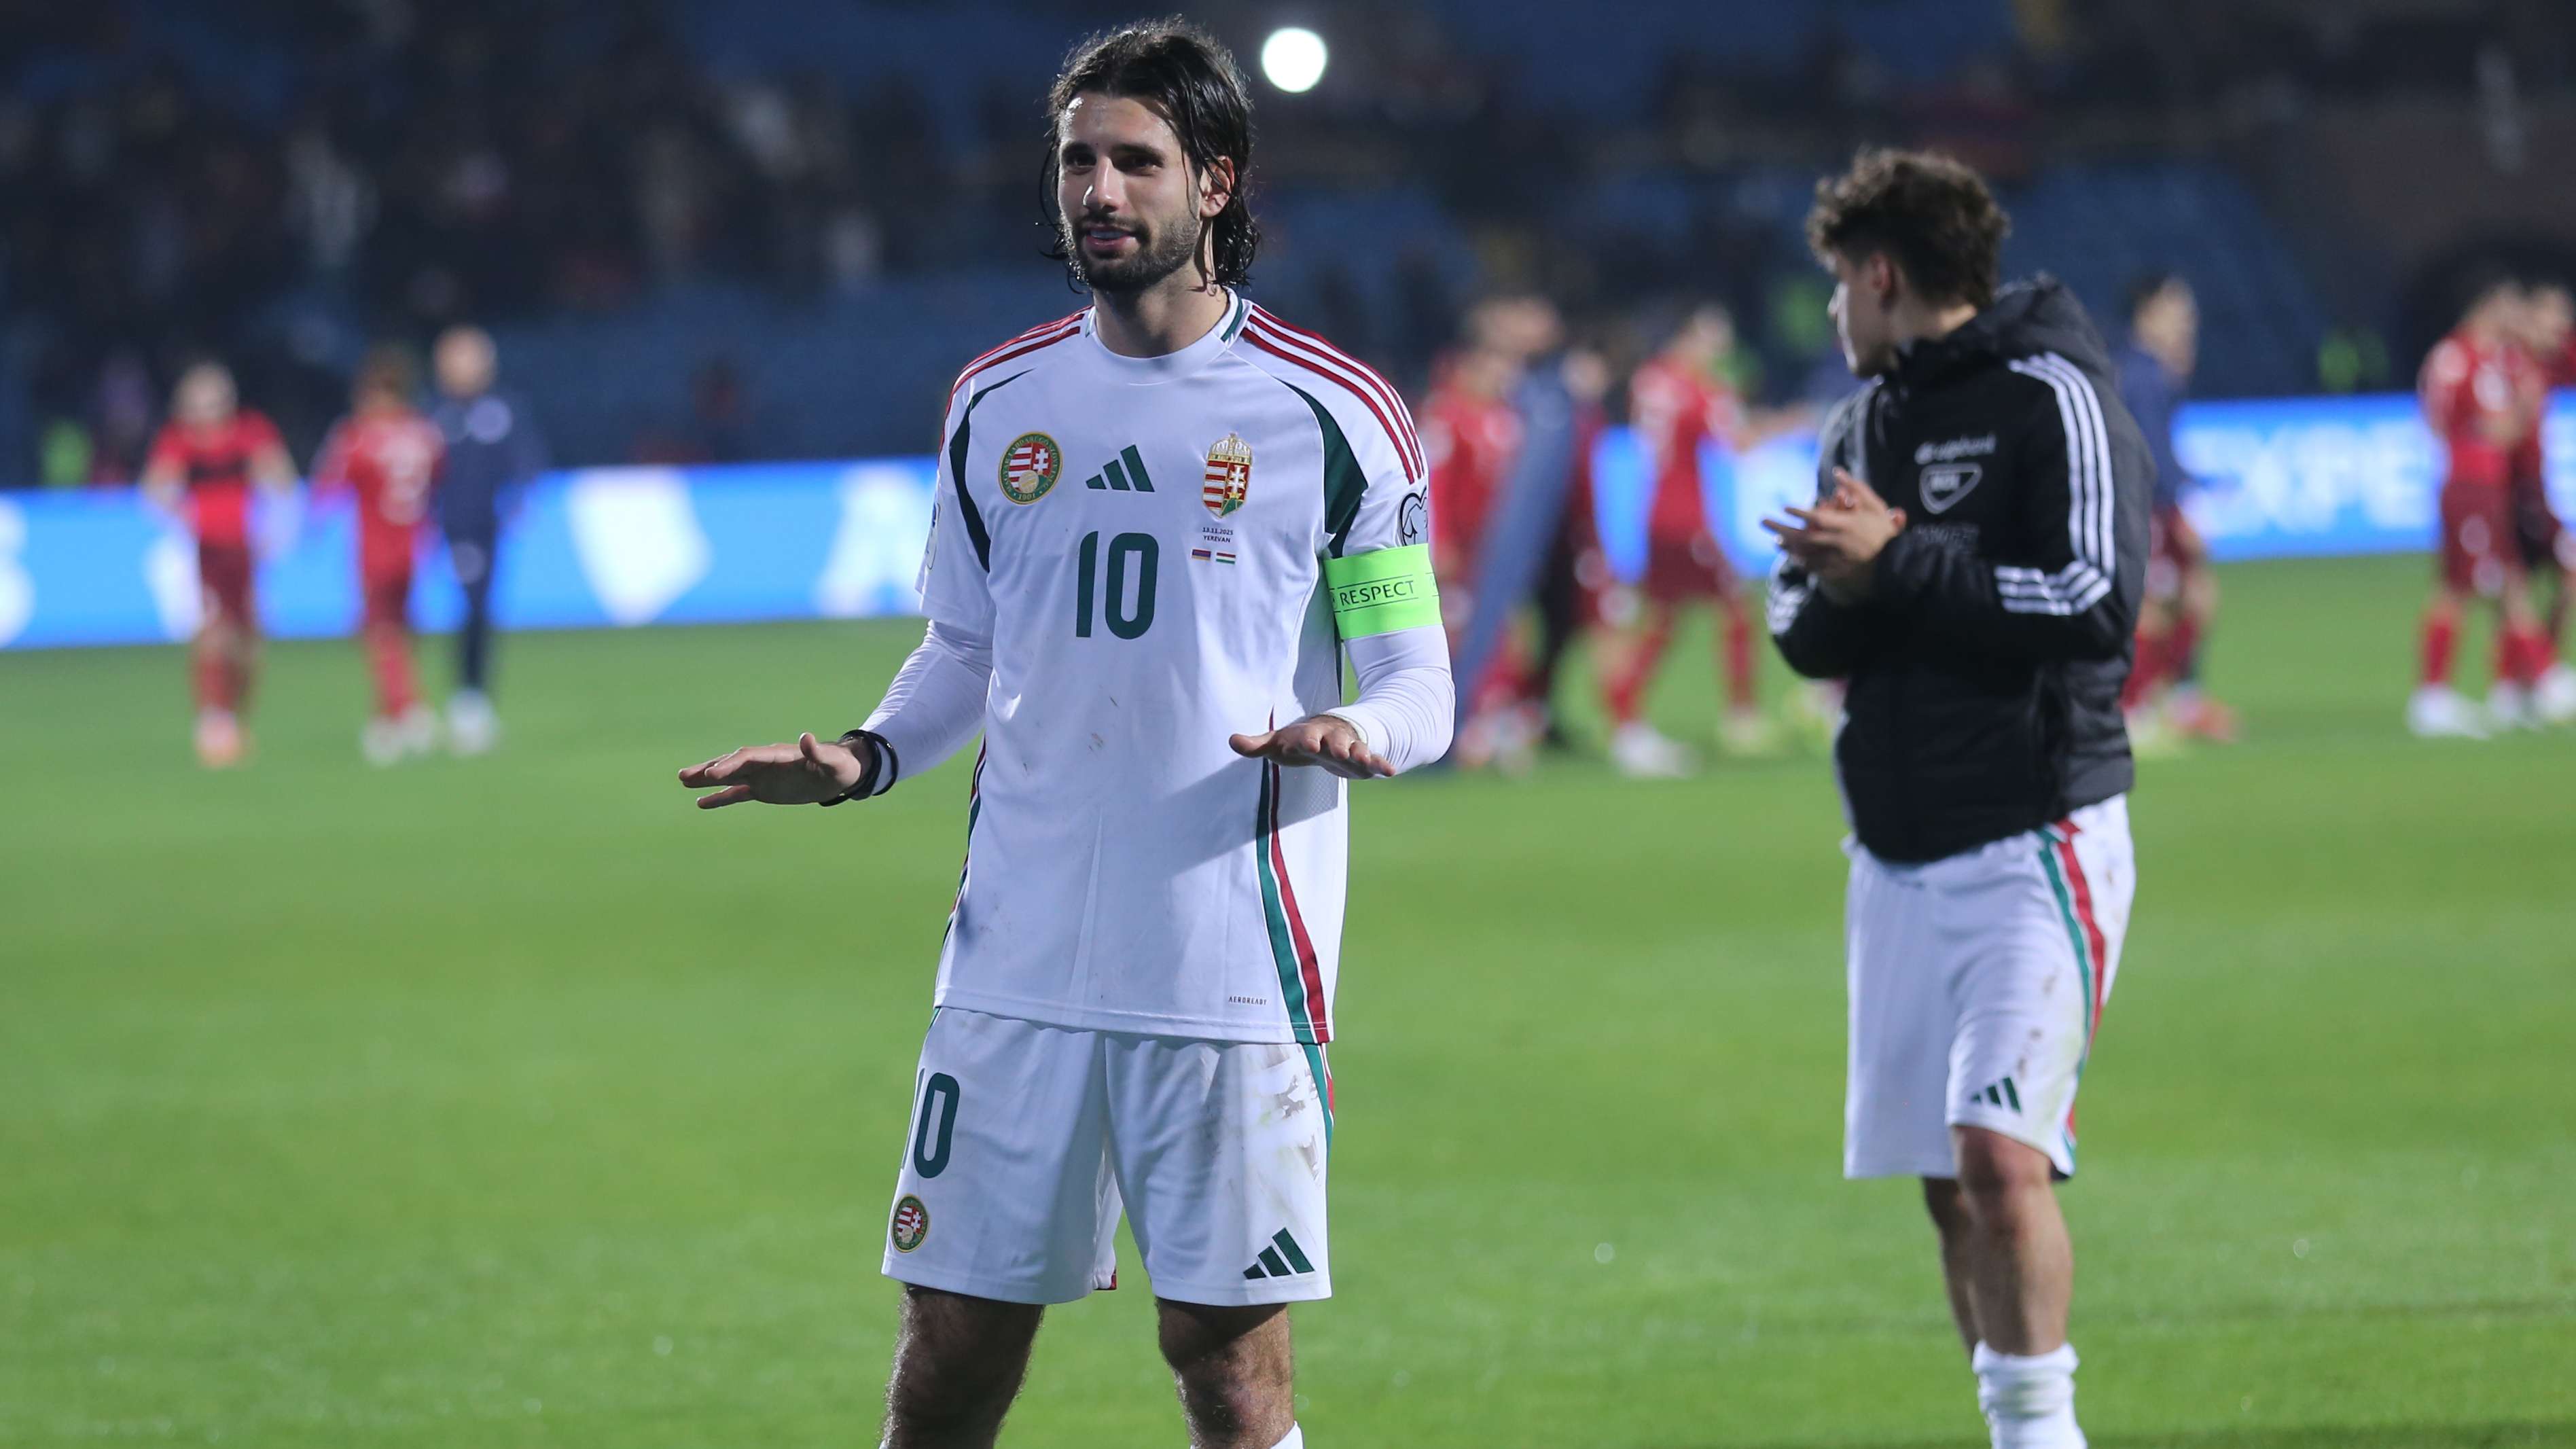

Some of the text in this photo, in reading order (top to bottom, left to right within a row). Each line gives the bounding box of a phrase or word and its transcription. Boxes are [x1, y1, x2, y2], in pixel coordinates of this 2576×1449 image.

[1203, 535, 1231, 543] YEREVAN
[1076, 531, 1159, 640] 10
[1340, 580, 1414, 606] RESPECT
[1228, 996, 1267, 1005] AEROREADY
